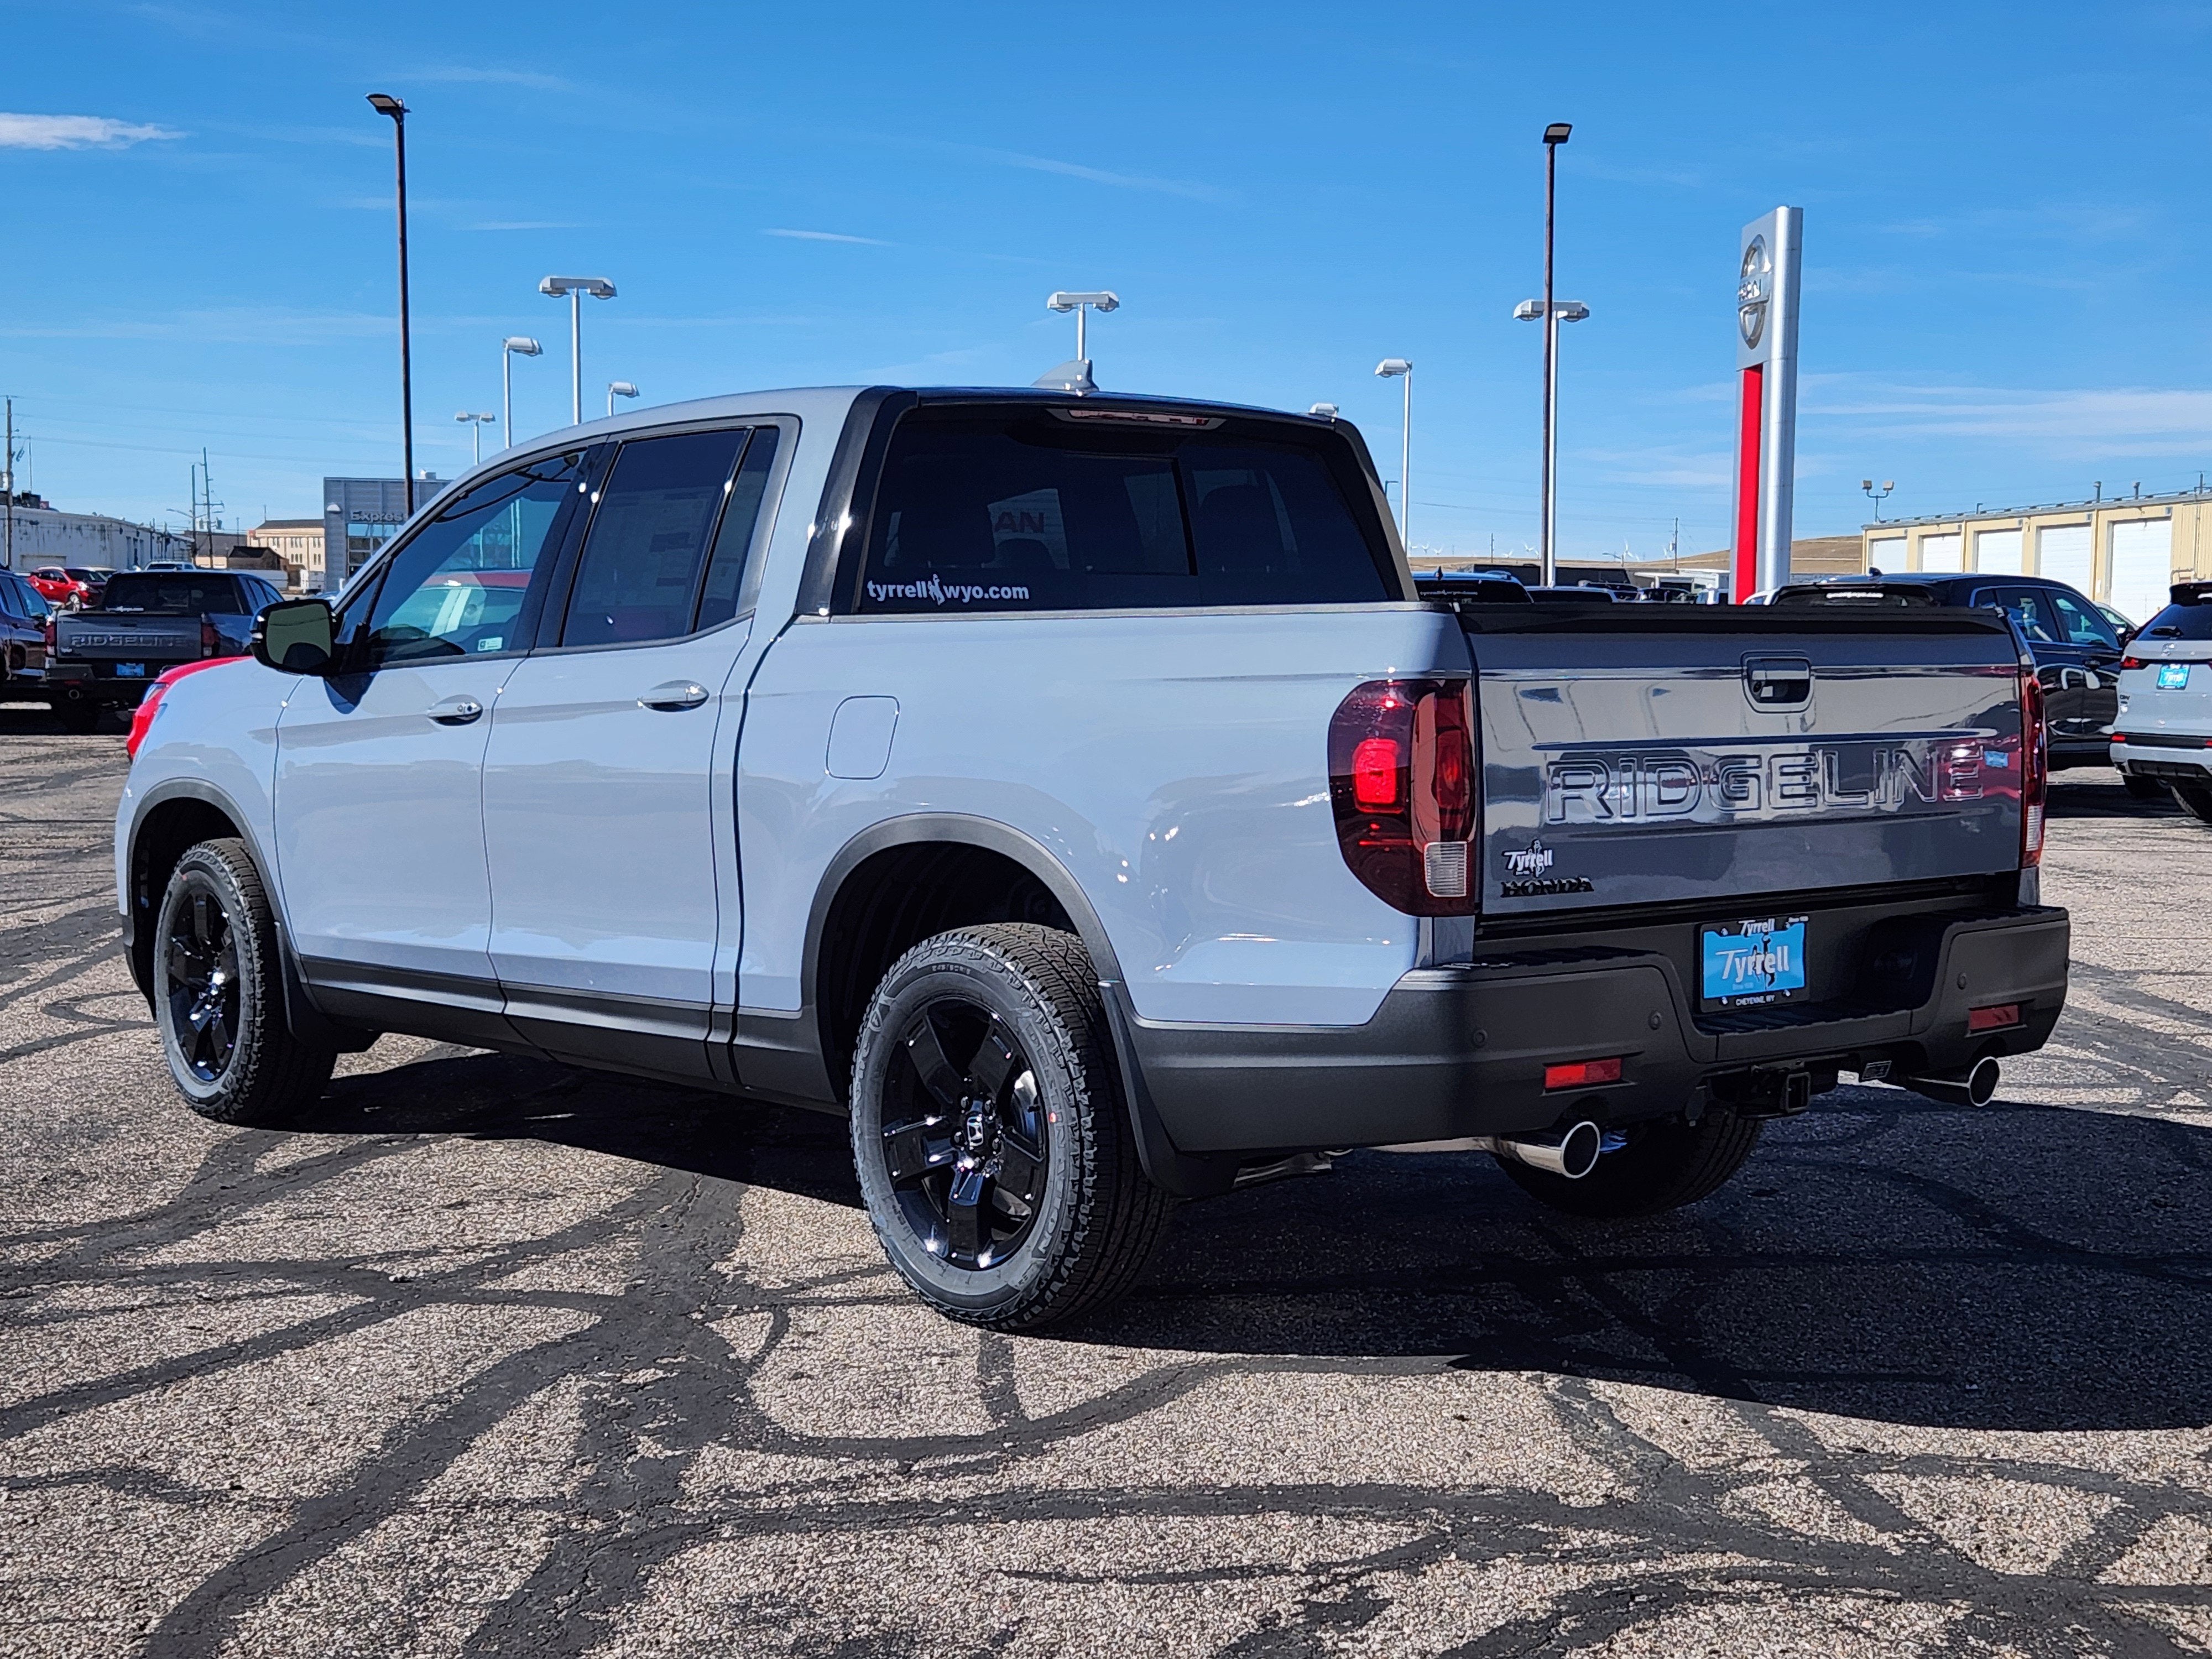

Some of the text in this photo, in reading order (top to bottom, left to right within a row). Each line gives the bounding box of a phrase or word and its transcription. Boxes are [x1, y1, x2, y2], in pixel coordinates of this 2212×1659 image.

[1547, 747, 1984, 822] RIDGELINE
[1504, 849, 1553, 872] Tyrrell
[1500, 877, 1594, 898] HONDA
[1738, 918, 1775, 936] Tyrrell
[1715, 946, 1790, 983] Tyrrell
